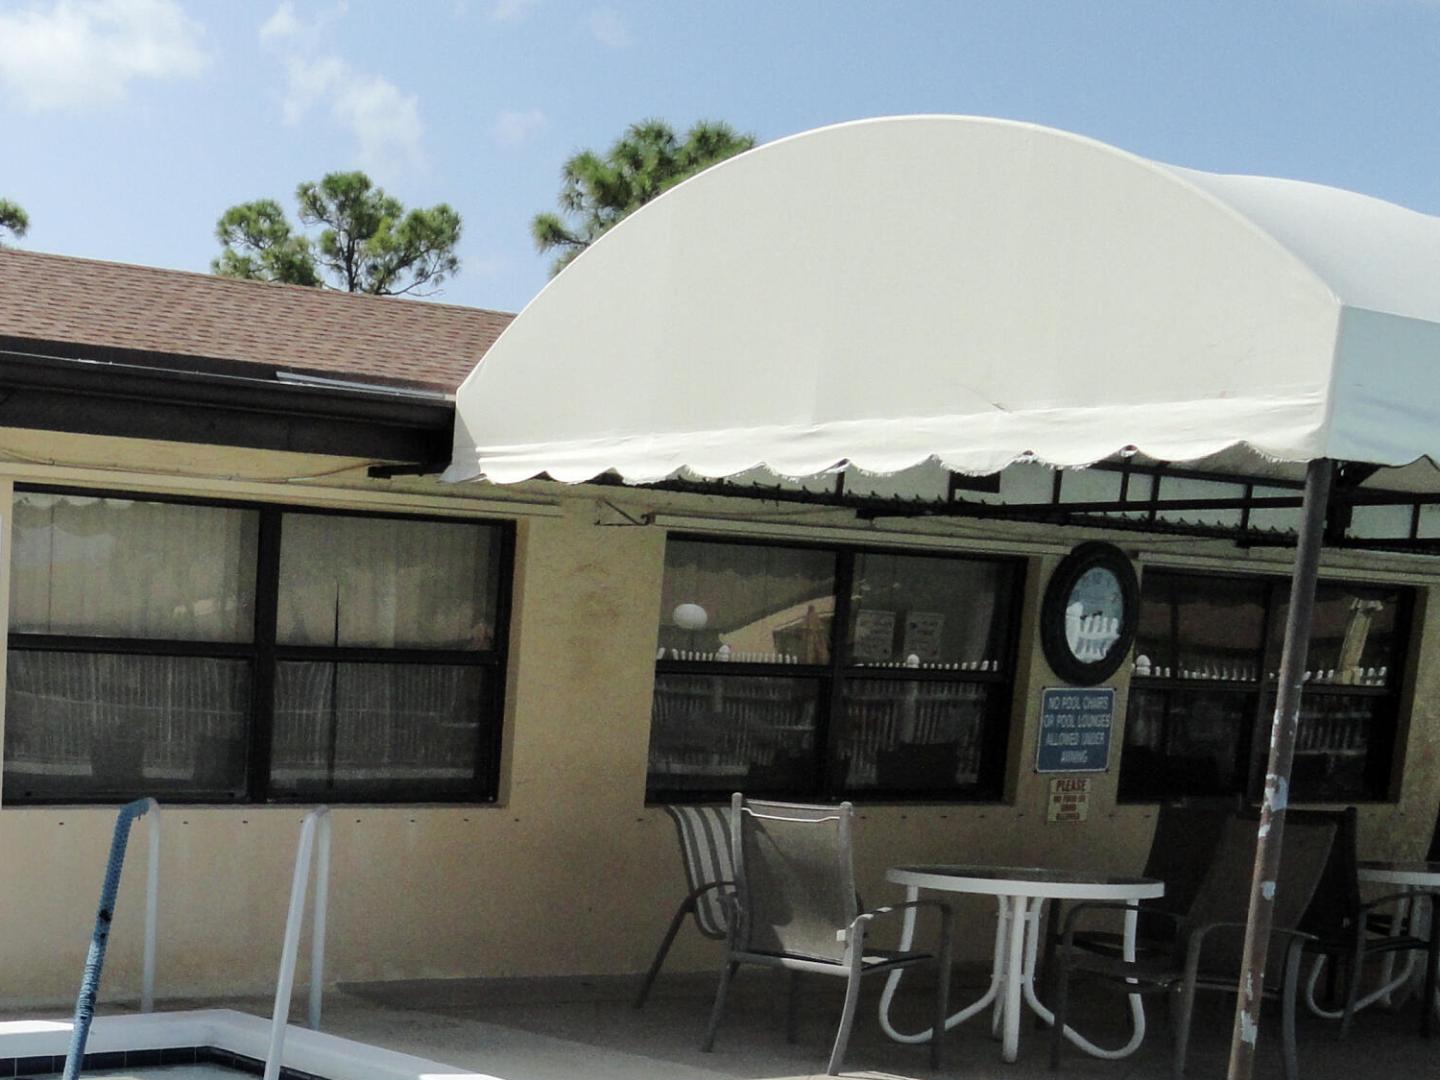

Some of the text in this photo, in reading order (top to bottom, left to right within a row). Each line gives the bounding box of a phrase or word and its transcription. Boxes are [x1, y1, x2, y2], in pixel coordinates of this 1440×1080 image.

[1048, 696, 1109, 710] NO POOL CHAIRS
[1044, 713, 1111, 728] OR POOL LOUNGES
[1046, 733, 1079, 746] ALLOWED
[1056, 779, 1086, 792] PLEASE
